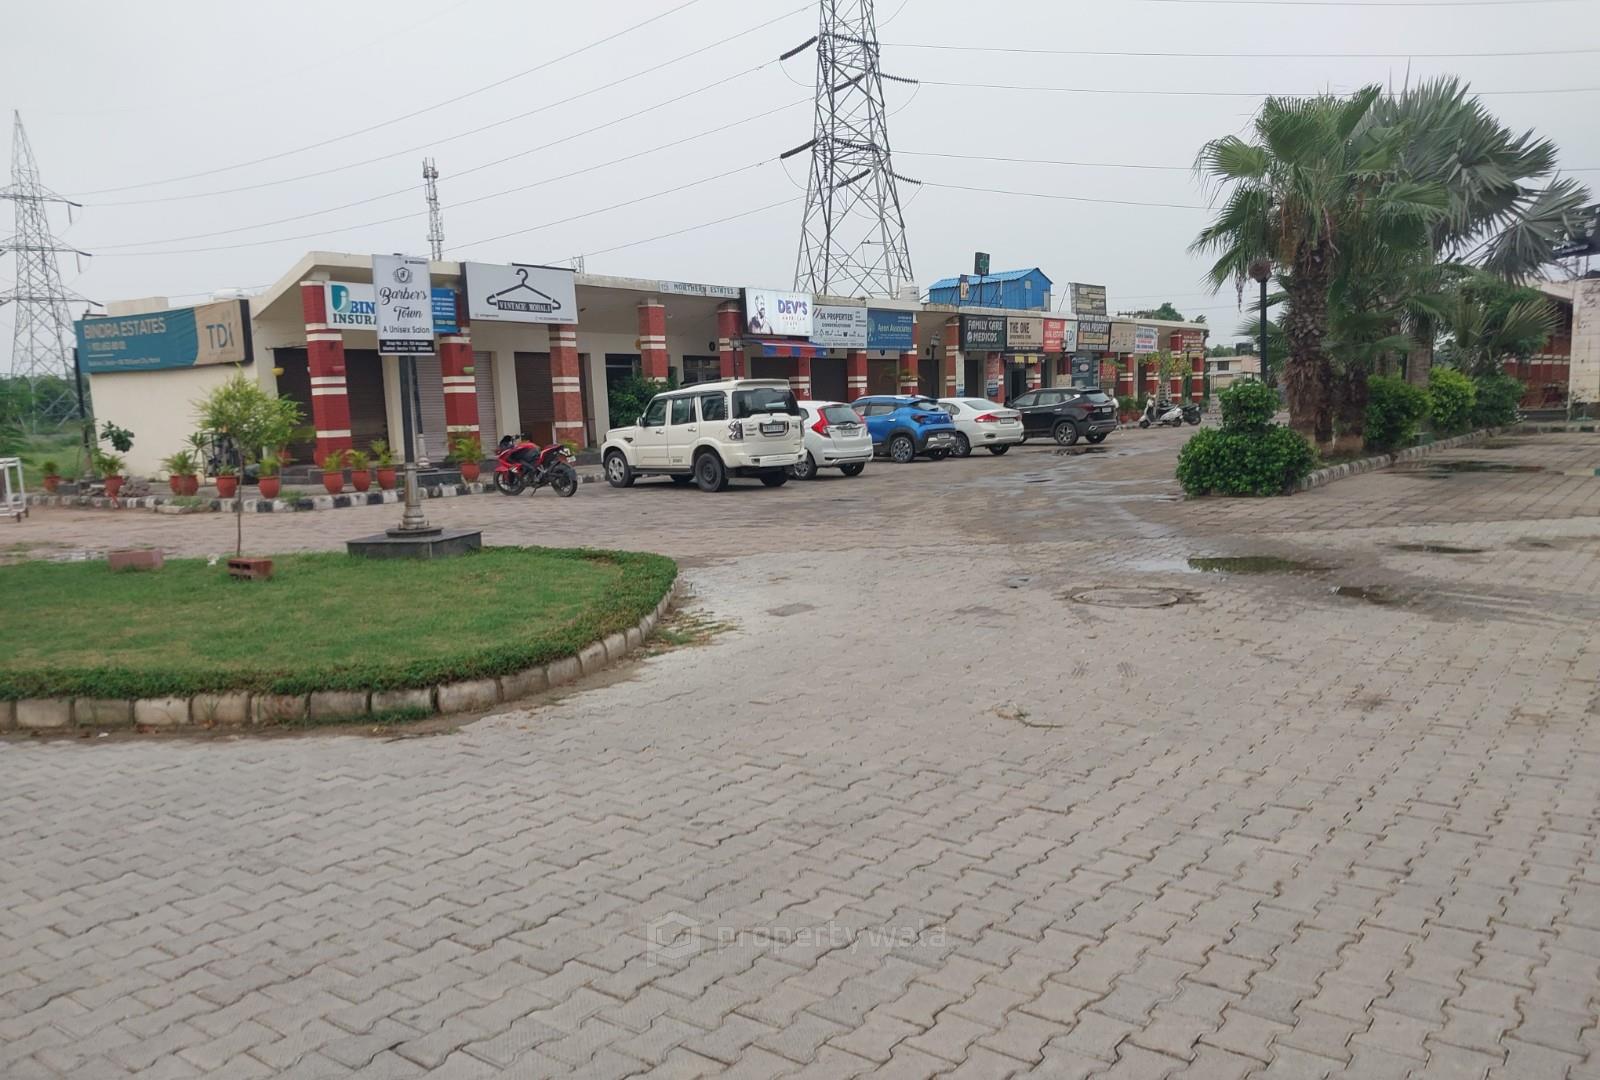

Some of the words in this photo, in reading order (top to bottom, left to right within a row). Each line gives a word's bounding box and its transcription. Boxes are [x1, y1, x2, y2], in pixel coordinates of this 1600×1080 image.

[380, 286, 428, 305] Barber's
[710, 286, 735, 295] ESTATES
[499, 301, 528, 311] VINTAGE
[777, 299, 808, 315] DEV'S
[393, 305, 423, 321] Town
[84, 322, 120, 340] BINDRA
[121, 317, 168, 338] ESTATES
[389, 326, 411, 334] Unisex
[412, 326, 430, 334] Salon
[967, 320, 987, 331] FAMILY
[988, 320, 1003, 331] CARE
[1019, 322, 1030, 334] ONE
[206, 322, 235, 350] TDI
[973, 332, 997, 342] MEDICOS
